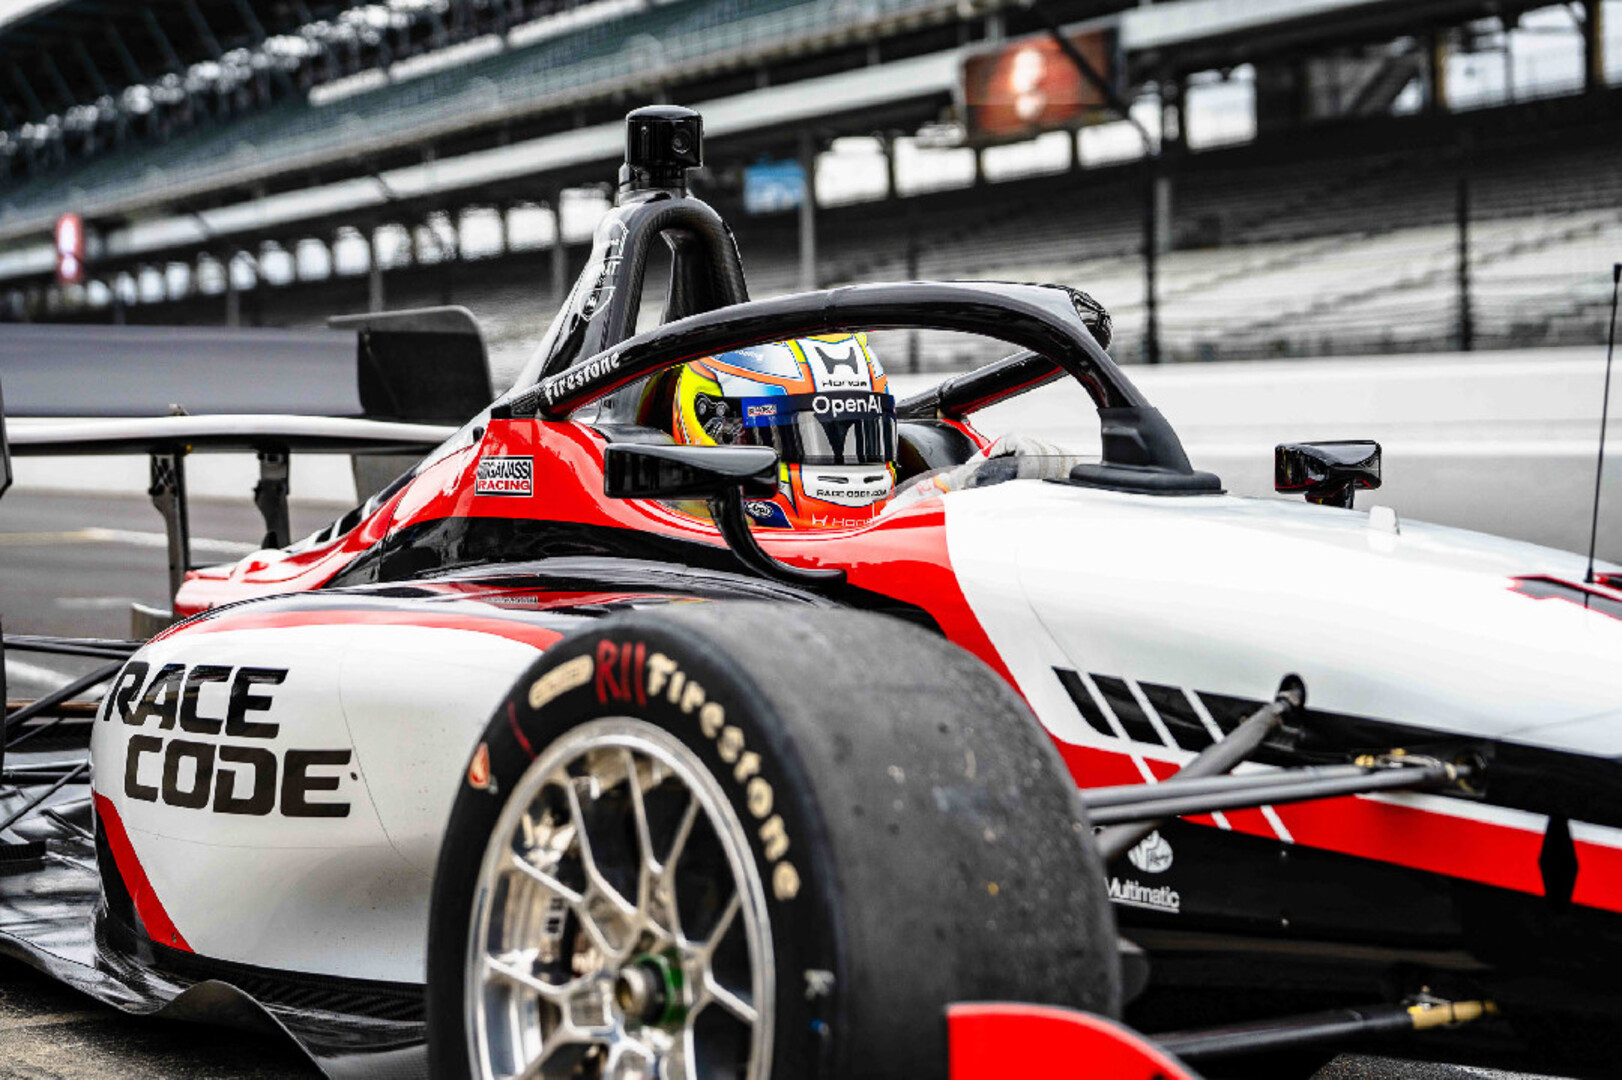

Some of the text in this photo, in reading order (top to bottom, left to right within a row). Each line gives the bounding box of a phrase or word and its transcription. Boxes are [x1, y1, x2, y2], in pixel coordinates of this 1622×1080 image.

[544, 352, 620, 405] Firestone
[812, 395, 883, 418] OpenAI
[478, 480, 530, 490] RACING
[103, 660, 289, 739] RACE
[124, 734, 352, 818] CODE
[646, 652, 801, 900] Firestone
[1104, 877, 1180, 908] Multimatic
